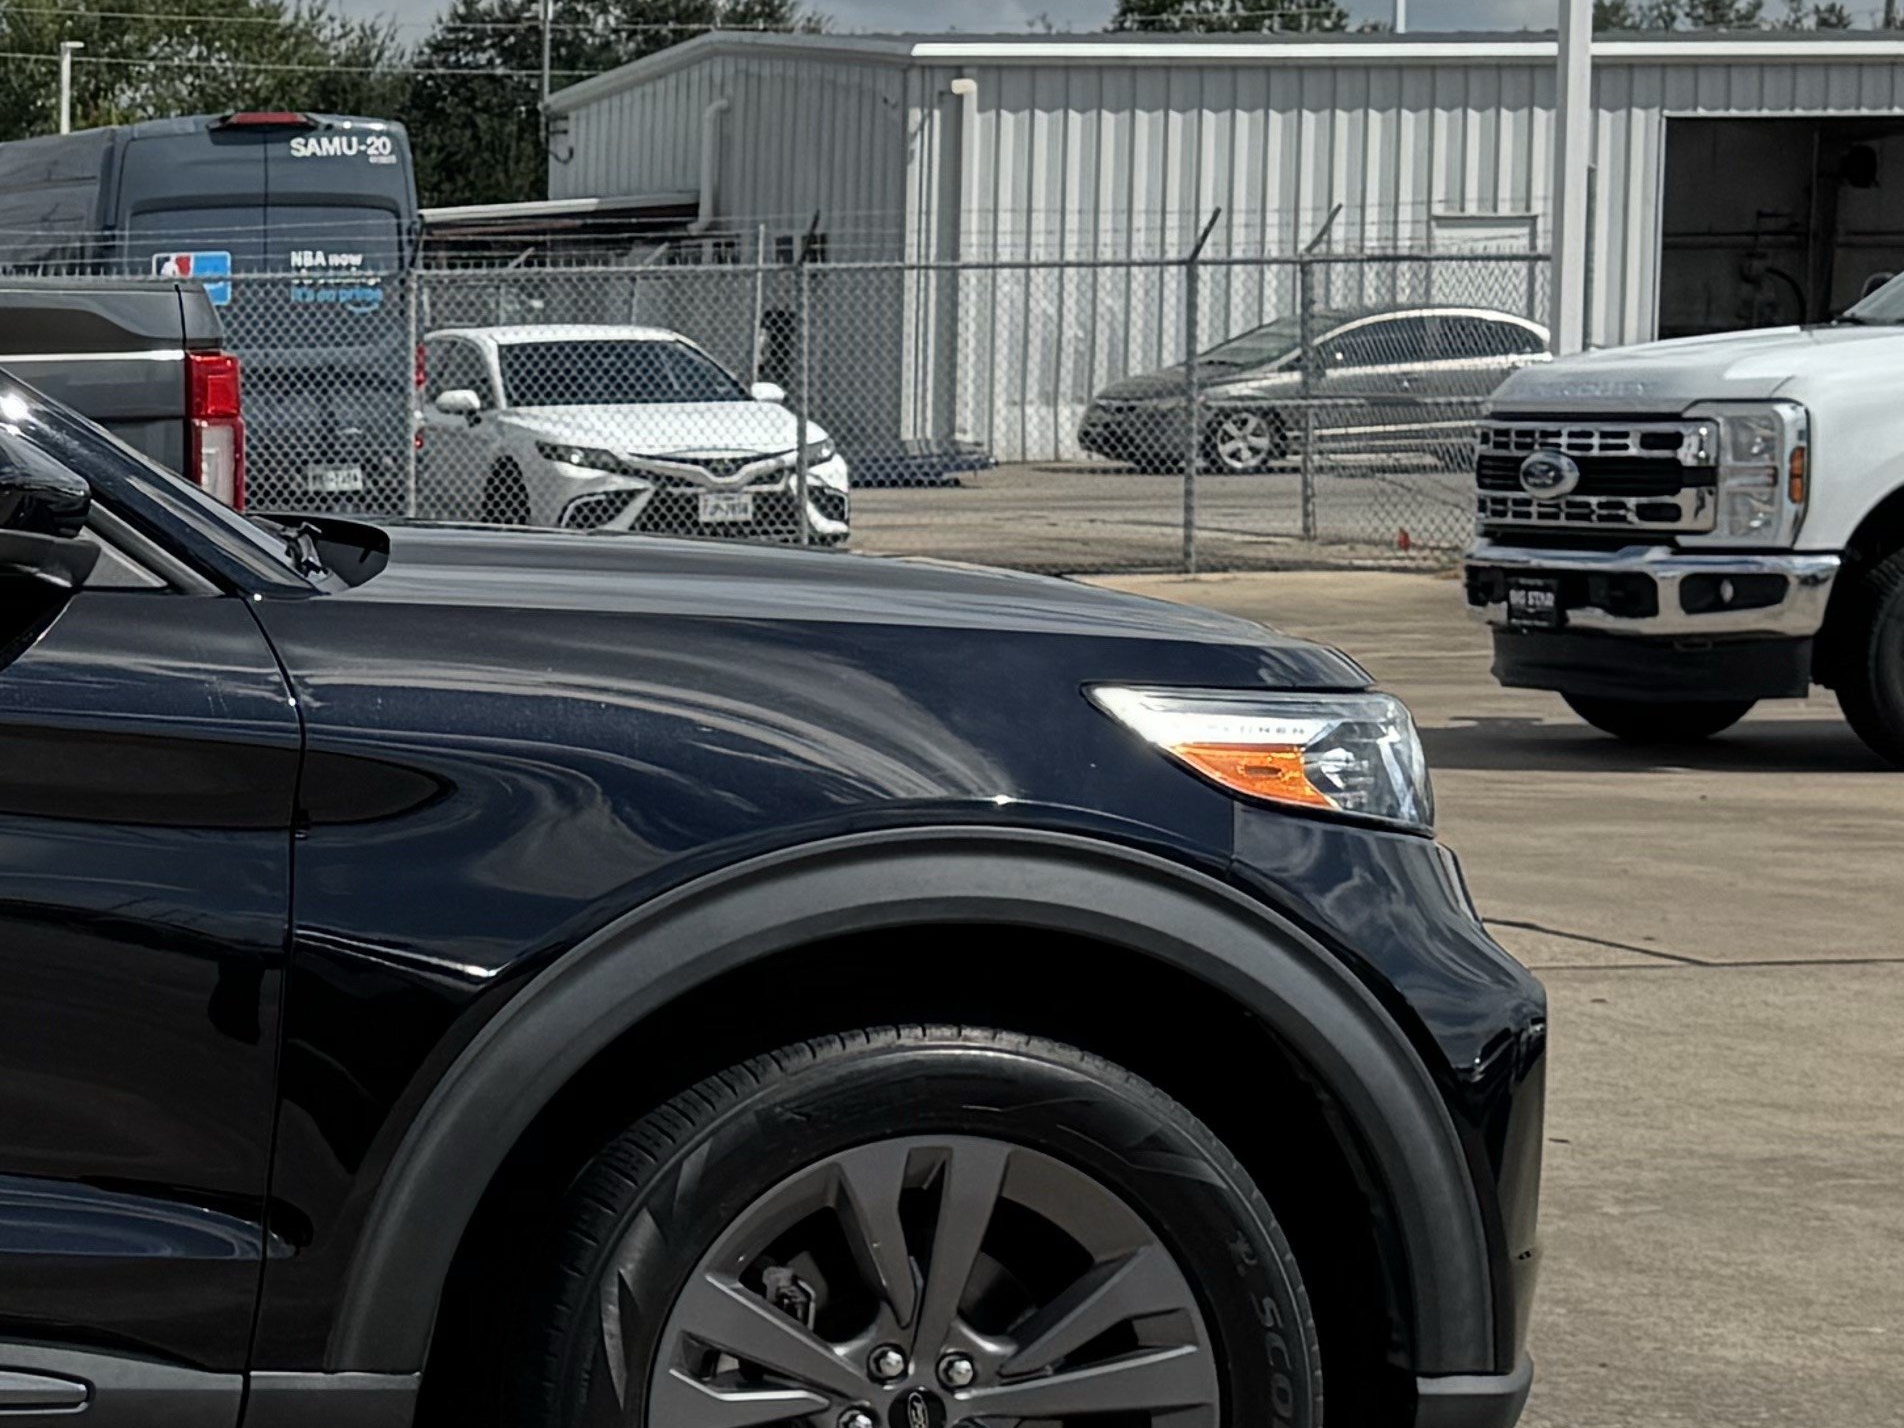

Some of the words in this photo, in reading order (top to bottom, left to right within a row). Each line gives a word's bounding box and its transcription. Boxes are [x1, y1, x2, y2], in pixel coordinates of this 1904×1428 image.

[290, 136, 392, 157] SAMU-20
[290, 250, 327, 267] NBA
[1528, 590, 1554, 607] STAR
